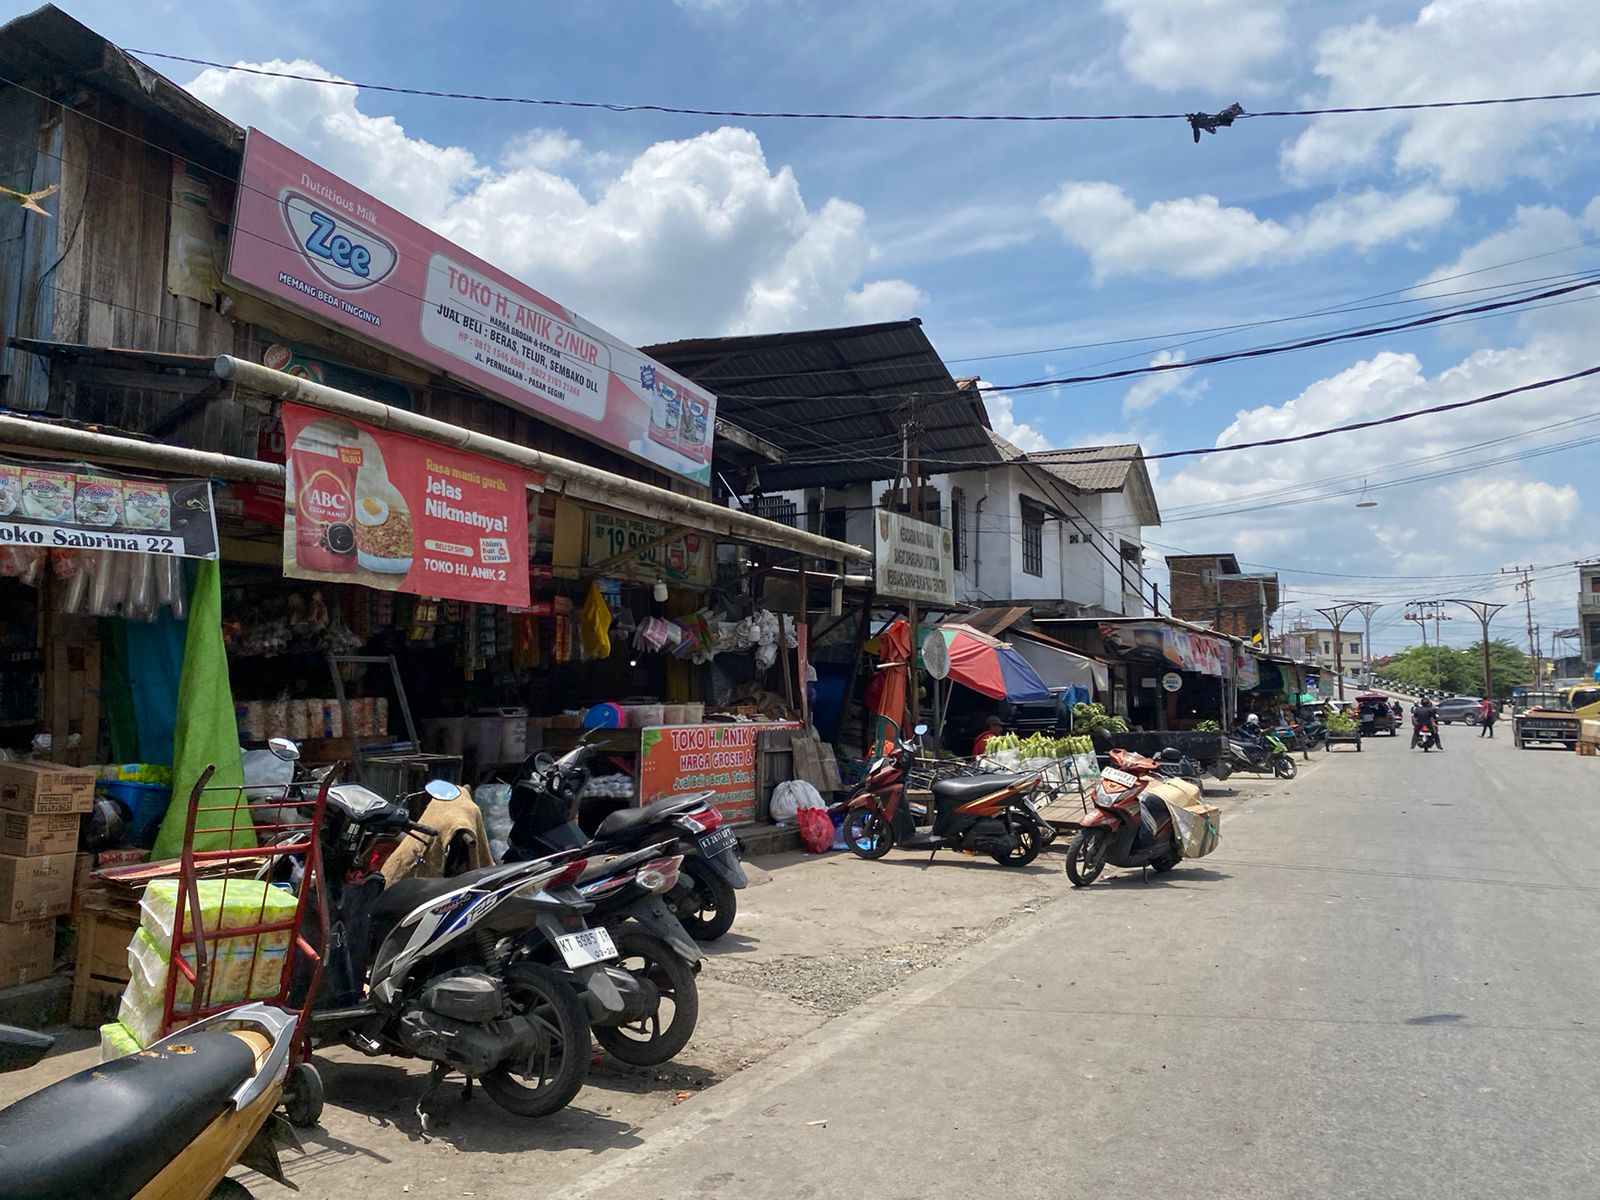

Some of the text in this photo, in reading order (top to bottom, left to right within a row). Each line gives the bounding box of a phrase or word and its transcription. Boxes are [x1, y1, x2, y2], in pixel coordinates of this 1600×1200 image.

[301, 173, 378, 225] Nutritious Milk
[306, 211, 371, 278] Zee
[279, 272, 381, 327] MEMANG BEDA TINGGINYA
[448, 265, 598, 365] TOKO H. ANIK 2/NUR
[437, 303, 460, 324] JUAL
[463, 315, 482, 335] BELI
[490, 329, 519, 355] BERAS,
[521, 345, 548, 369] TELUR,
[550, 360, 584, 386] SEMBAKO
[586, 377, 598, 393] DLL
[458, 331, 468, 342] HP
[489, 315, 510, 333] HARGA
[511, 327, 532, 344] GROSIR
[539, 341, 561, 359] ECERAN
[475, 352, 485, 363] JL.
[485, 357, 523, 381] PERNIAGAAN
[528, 378, 546, 393] PASAR
[547, 386, 565, 401] SEGIRI
[426, 458, 450, 475] Rasa
[452, 467, 480, 484] manis
[310, 489, 346, 510] ABC
[426, 476, 462, 501] Jelas
[425, 498, 508, 534] Nikmatnya!
[53, 529, 140, 551] Sabrina
[146, 537, 174, 554] 22
[424, 558, 453, 573] TOKO
[471, 567, 496, 580] ANIK
[498, 570, 506, 581] 2
[672, 729, 705, 752] TOKO
[708, 728, 719, 749] H.
[722, 727, 749, 747] ANIK
[680, 749, 752, 772] HARGA GROSIR &
[673, 775, 692, 790] Jual
[558, 939, 573, 952] KT
